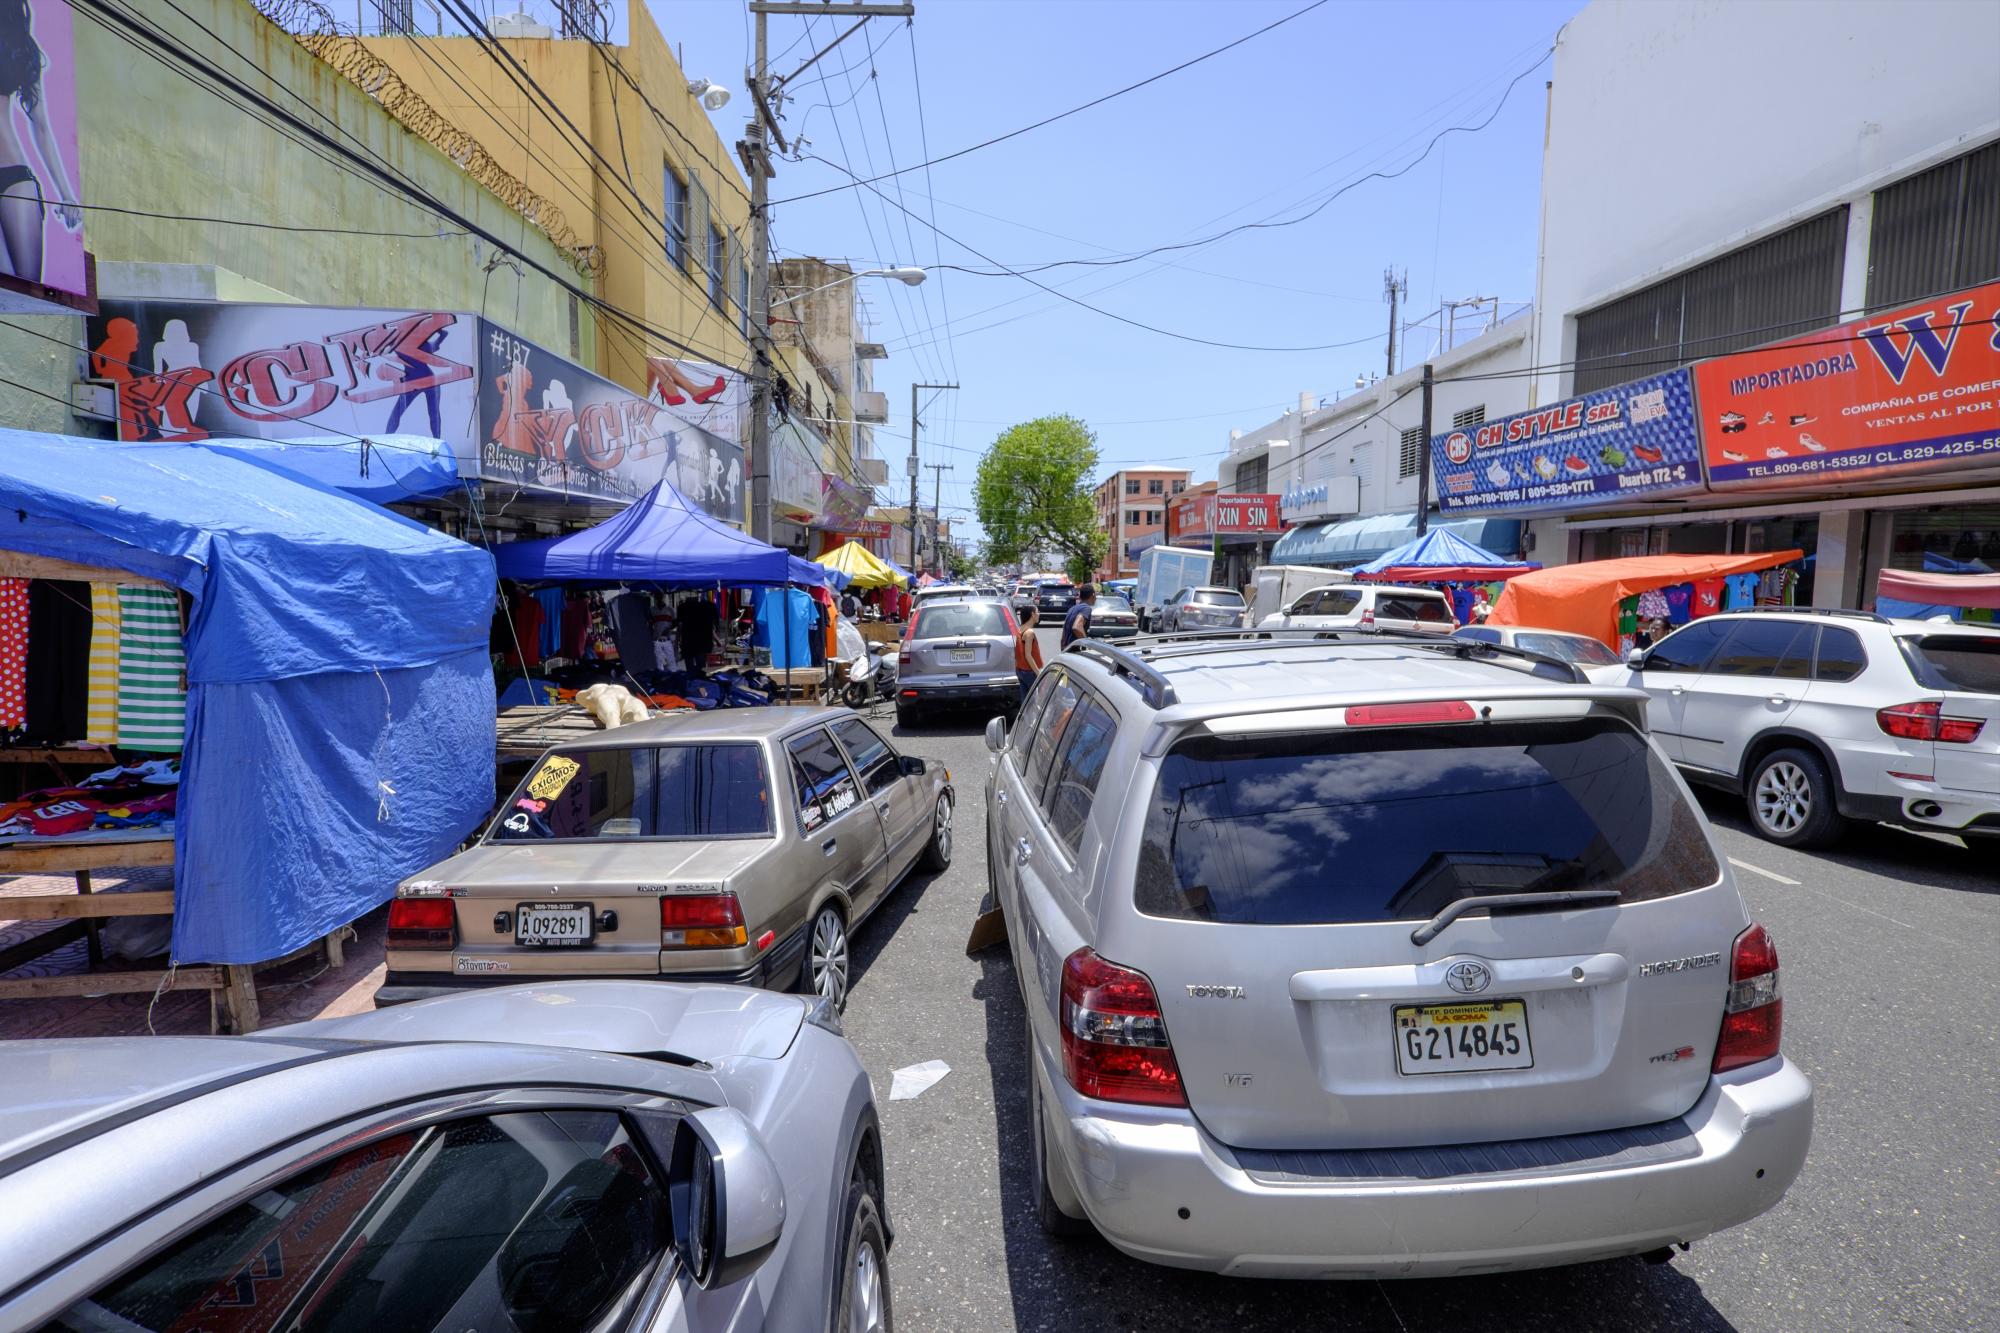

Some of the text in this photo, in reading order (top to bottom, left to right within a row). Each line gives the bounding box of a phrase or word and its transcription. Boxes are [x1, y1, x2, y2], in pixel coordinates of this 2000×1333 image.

[490, 330, 530, 368] #187
[1730, 352, 1858, 397] IMPORTADORA
[1841, 394, 1914, 416] COMPAÑIA
[1918, 391, 1938, 403] DE
[1865, 411, 1926, 429] VENTAS
[1929, 408, 1952, 421] AL
[1955, 400, 1992, 415] POR
[1477, 423, 1504, 448] CH
[1507, 401, 1584, 442] STYLE
[1587, 400, 1621, 423] SRL
[483, 442, 525, 474] Blusas
[1618, 473, 1652, 489] Duarte
[1218, 507, 1268, 526] XIN SIN
[531, 763, 577, 793] EXIGIMOS
[522, 916, 584, 935] A092891
[1639, 951, 1721, 977] HIGHLANDER
[1186, 985, 1246, 1000] TOYOTA
[1443, 1006, 1496, 1014] DOMINICANA
[1406, 1022, 1520, 1060] G214845
[1223, 1072, 1255, 1088] V6
